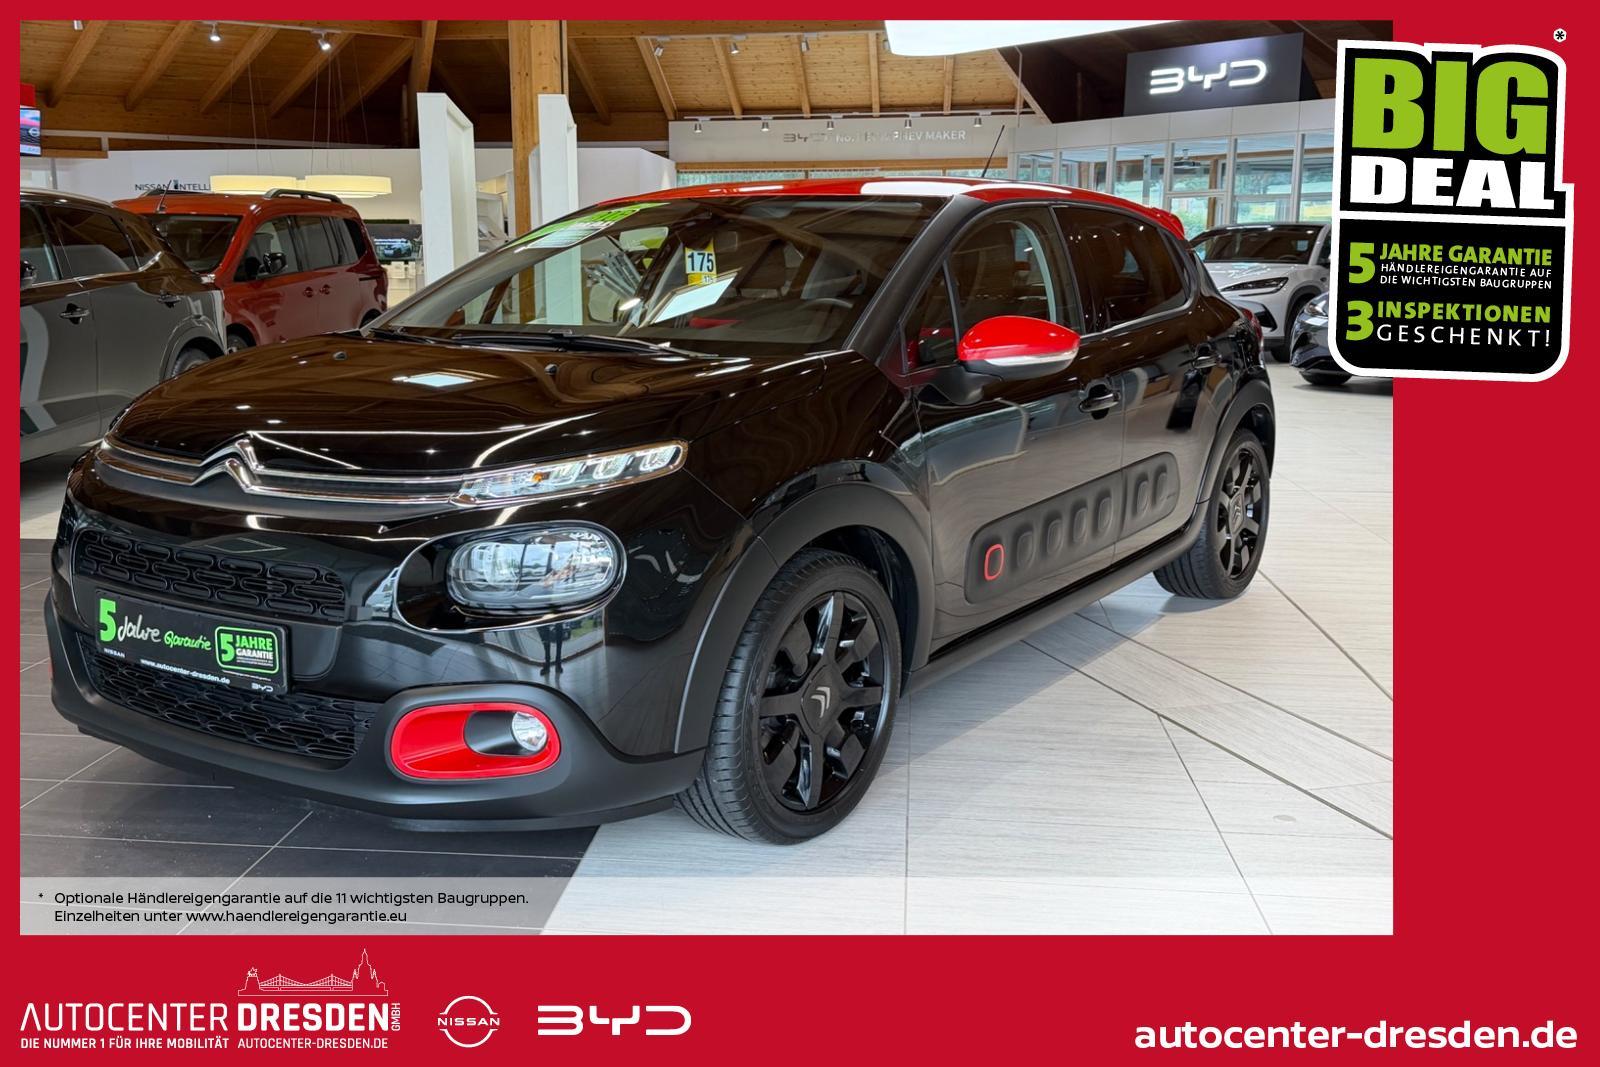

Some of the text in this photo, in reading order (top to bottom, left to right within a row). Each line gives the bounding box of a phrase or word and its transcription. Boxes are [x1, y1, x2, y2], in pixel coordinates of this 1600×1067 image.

[1149, 58, 1267, 95] BYD
[925, 130, 967, 141] MAKER
[687, 252, 714, 272] 175
[99, 598, 117, 642] 5
[220, 633, 235, 662] 5
[235, 634, 273, 651] JAHRE
[235, 647, 274, 660] GARANTIE
[140, 658, 231, 685] www.autocenter-dresden.de
